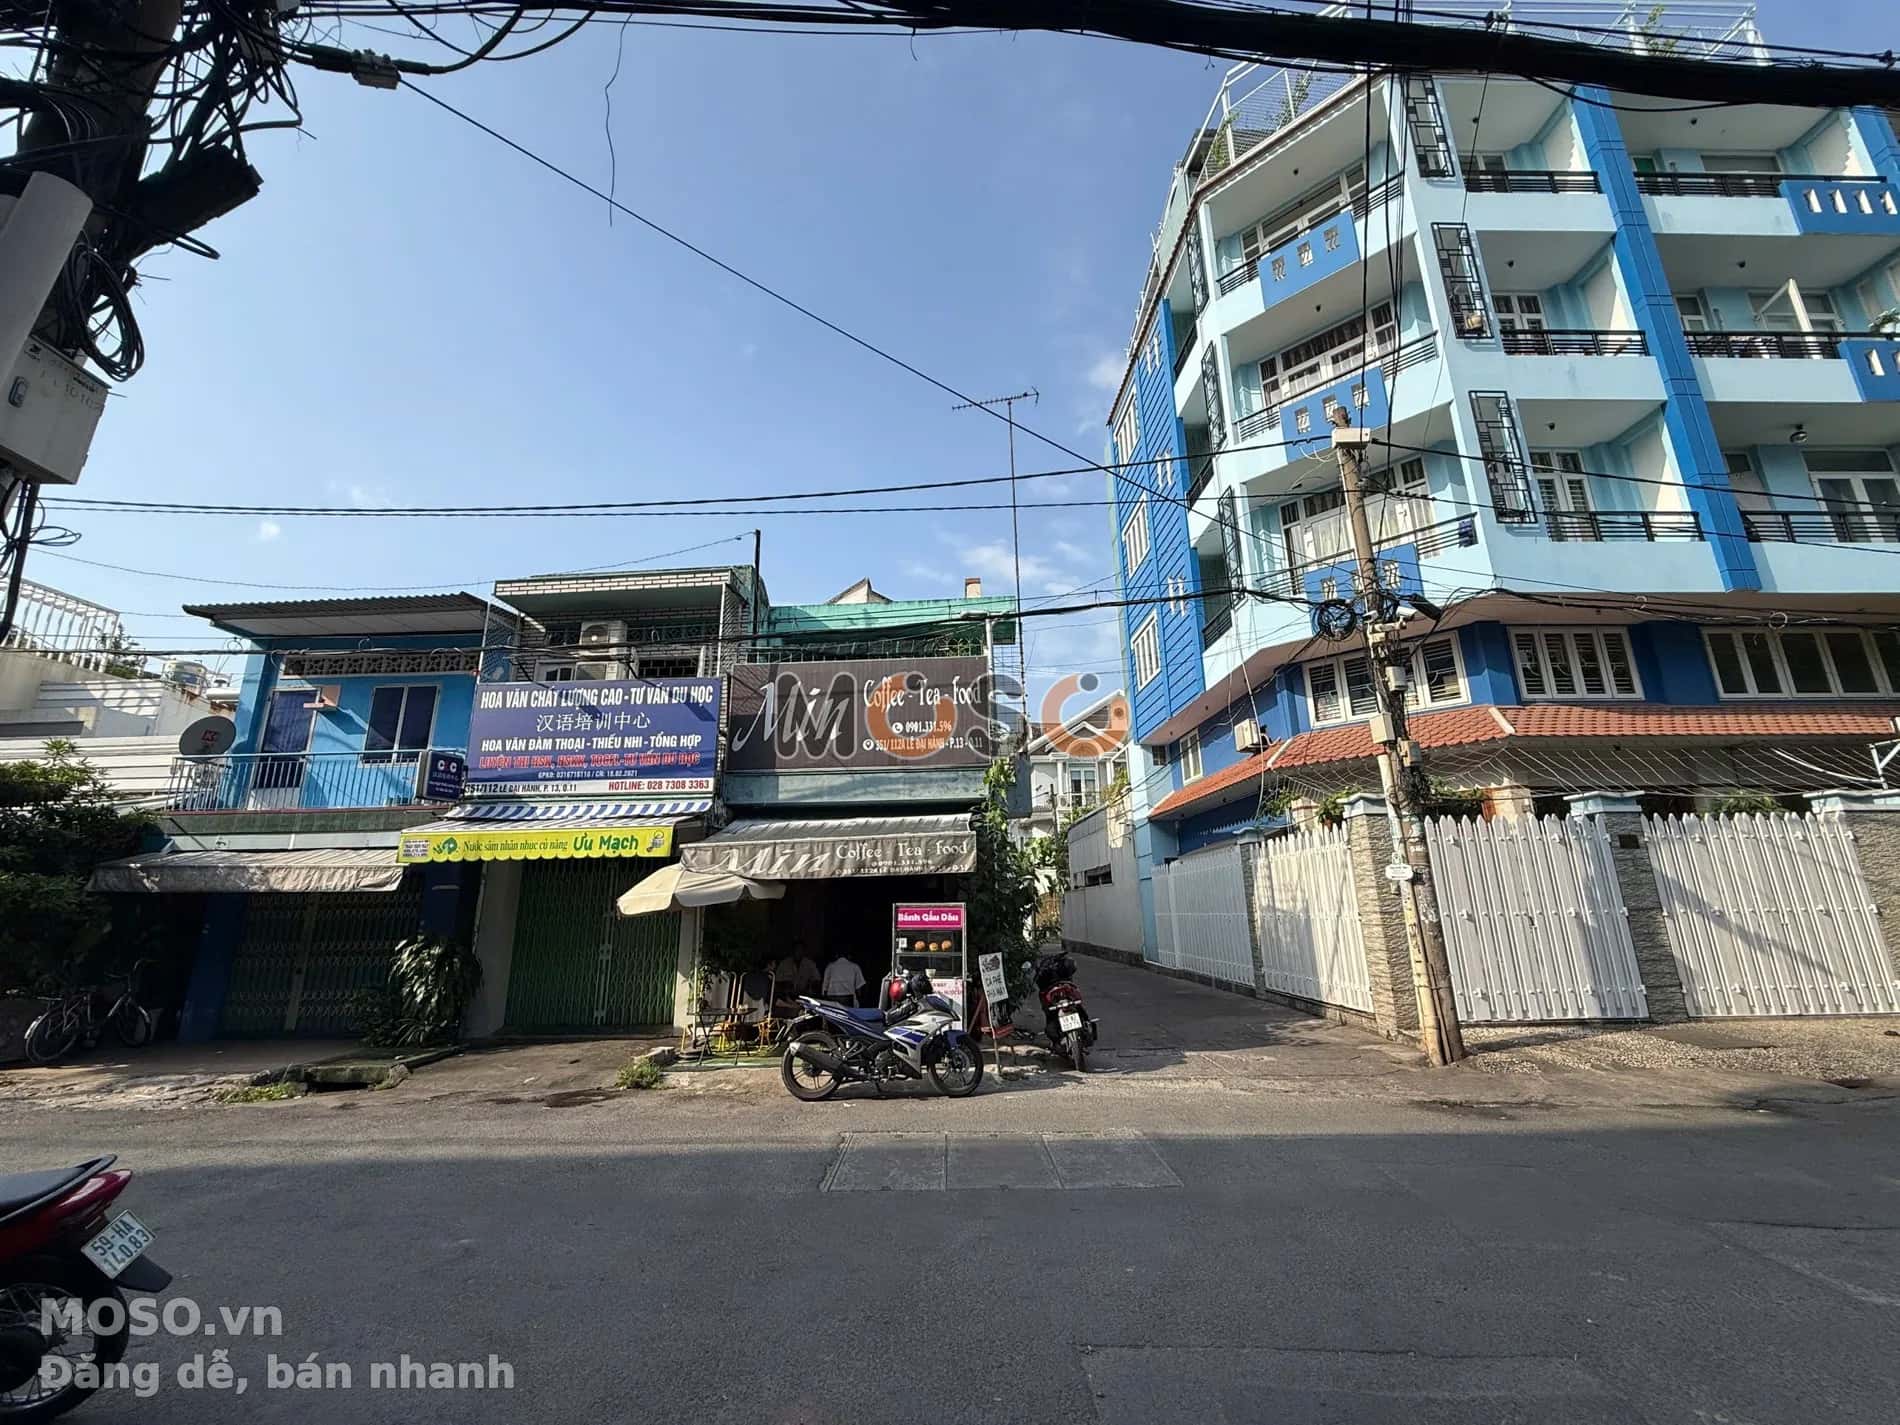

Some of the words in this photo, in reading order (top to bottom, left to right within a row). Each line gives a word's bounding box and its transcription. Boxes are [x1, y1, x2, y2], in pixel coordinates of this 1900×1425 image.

[481, 690, 503, 709] HOA
[505, 688, 528, 709] VĂN
[530, 686, 560, 708] CHẤT
[561, 687, 598, 710] LƯỢNG
[600, 687, 623, 706] CAO
[630, 686, 646, 705] TƯ
[647, 682, 670, 704] VẤN
[671, 686, 688, 704] DU
[690, 685, 714, 707] HỌC
[863, 676, 905, 713] Coffee
[917, 678, 942, 706] Tea
[536, 711, 651, 732] 汉语培训中心
[732, 681, 851, 752] Min
[481, 739, 503, 752] HOA
[505, 737, 527, 752] VĂN
[528, 736, 553, 751] ĐÀM
[555, 738, 585, 752] THOẠI
[591, 733, 622, 749] THIẾU
[623, 736, 643, 749] NHI
[649, 731, 677, 748] TỔNG
[680, 734, 702, 749] HỢP
[906, 736, 915, 750] LÊ
[608, 781, 645, 791] HOTLINE:
[647, 780, 662, 790] 028
[688, 779, 710, 789] 3363
[599, 834, 639, 854] Mạch
[836, 840, 883, 861] Coffee
[897, 842, 923, 857] Tea
[90, 1219, 135, 1256] 59-HA
[103, 1229, 150, 1271] 140.83
